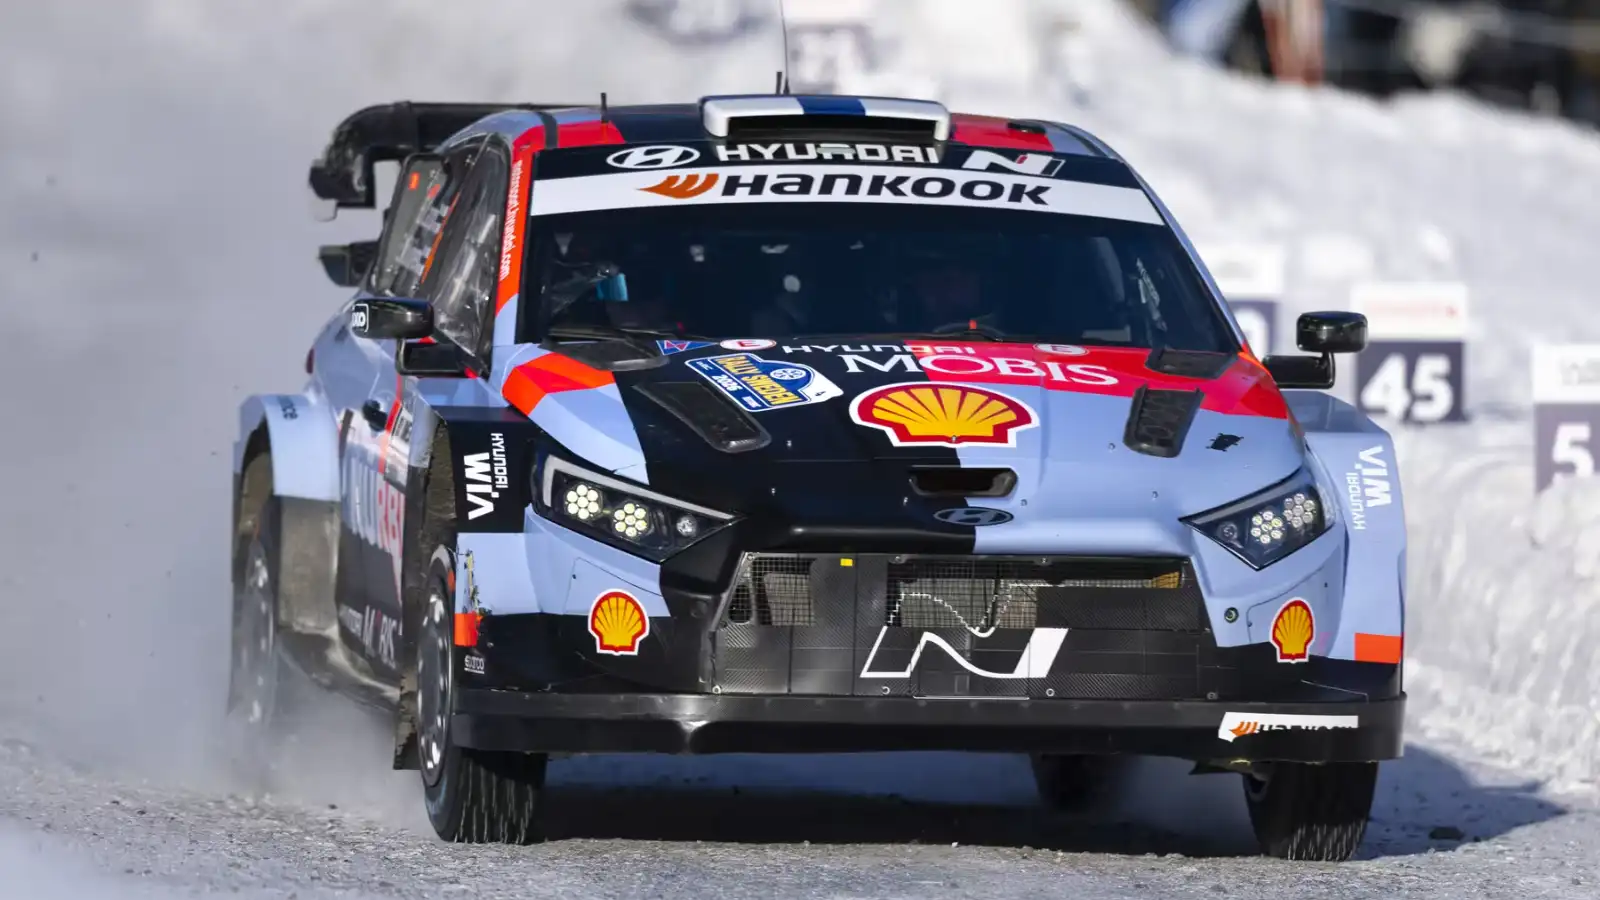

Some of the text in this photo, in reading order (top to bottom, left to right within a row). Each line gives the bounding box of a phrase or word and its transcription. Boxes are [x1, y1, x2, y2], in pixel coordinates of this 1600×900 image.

[716, 143, 939, 163] HYUNDAI
[721, 173, 1053, 206] HANKOOK
[782, 344, 976, 355] HYUNDAI
[837, 353, 1119, 386] MOBIS
[714, 356, 762, 374] RALLY
[741, 374, 804, 405] SWEDEN
[1360, 352, 1454, 421] 45
[463, 452, 500, 521] WIA
[490, 432, 509, 489] HYUNDAI
[1354, 445, 1392, 508] WIA
[1345, 472, 1367, 530] HYUNDAI
